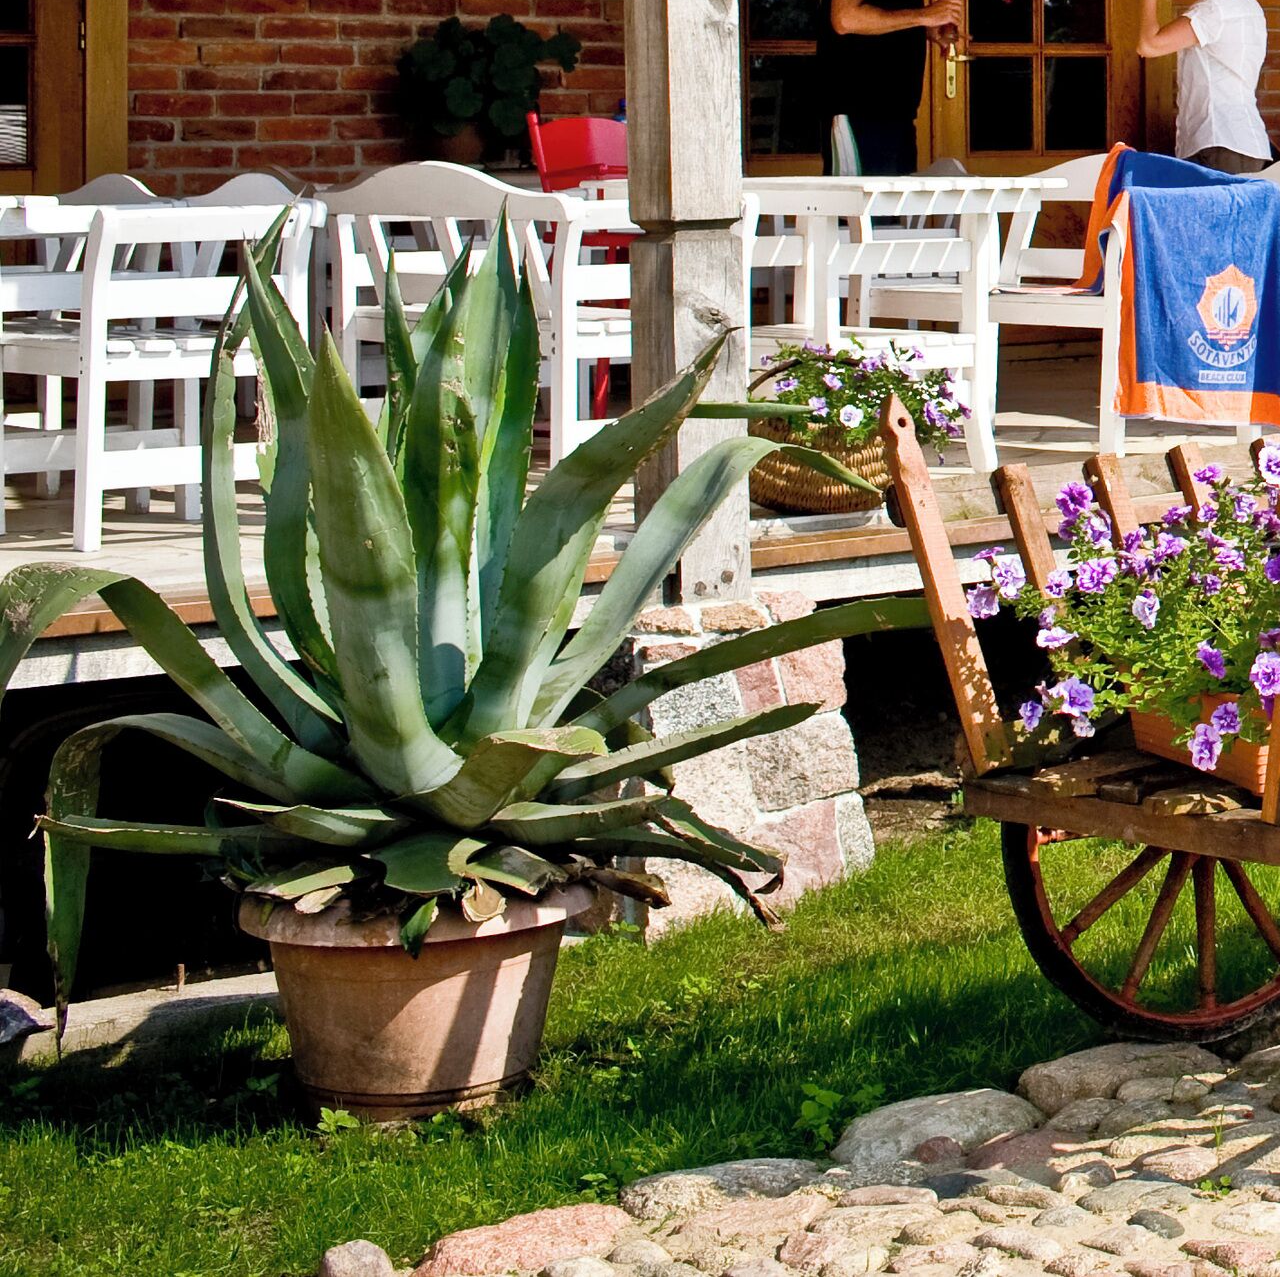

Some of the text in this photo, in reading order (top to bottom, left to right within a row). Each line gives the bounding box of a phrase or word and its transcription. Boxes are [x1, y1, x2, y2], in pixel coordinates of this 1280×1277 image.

[1189, 335, 1256, 366] SOTAVENTO
[1201, 373, 1245, 382] BEACH CLUB
